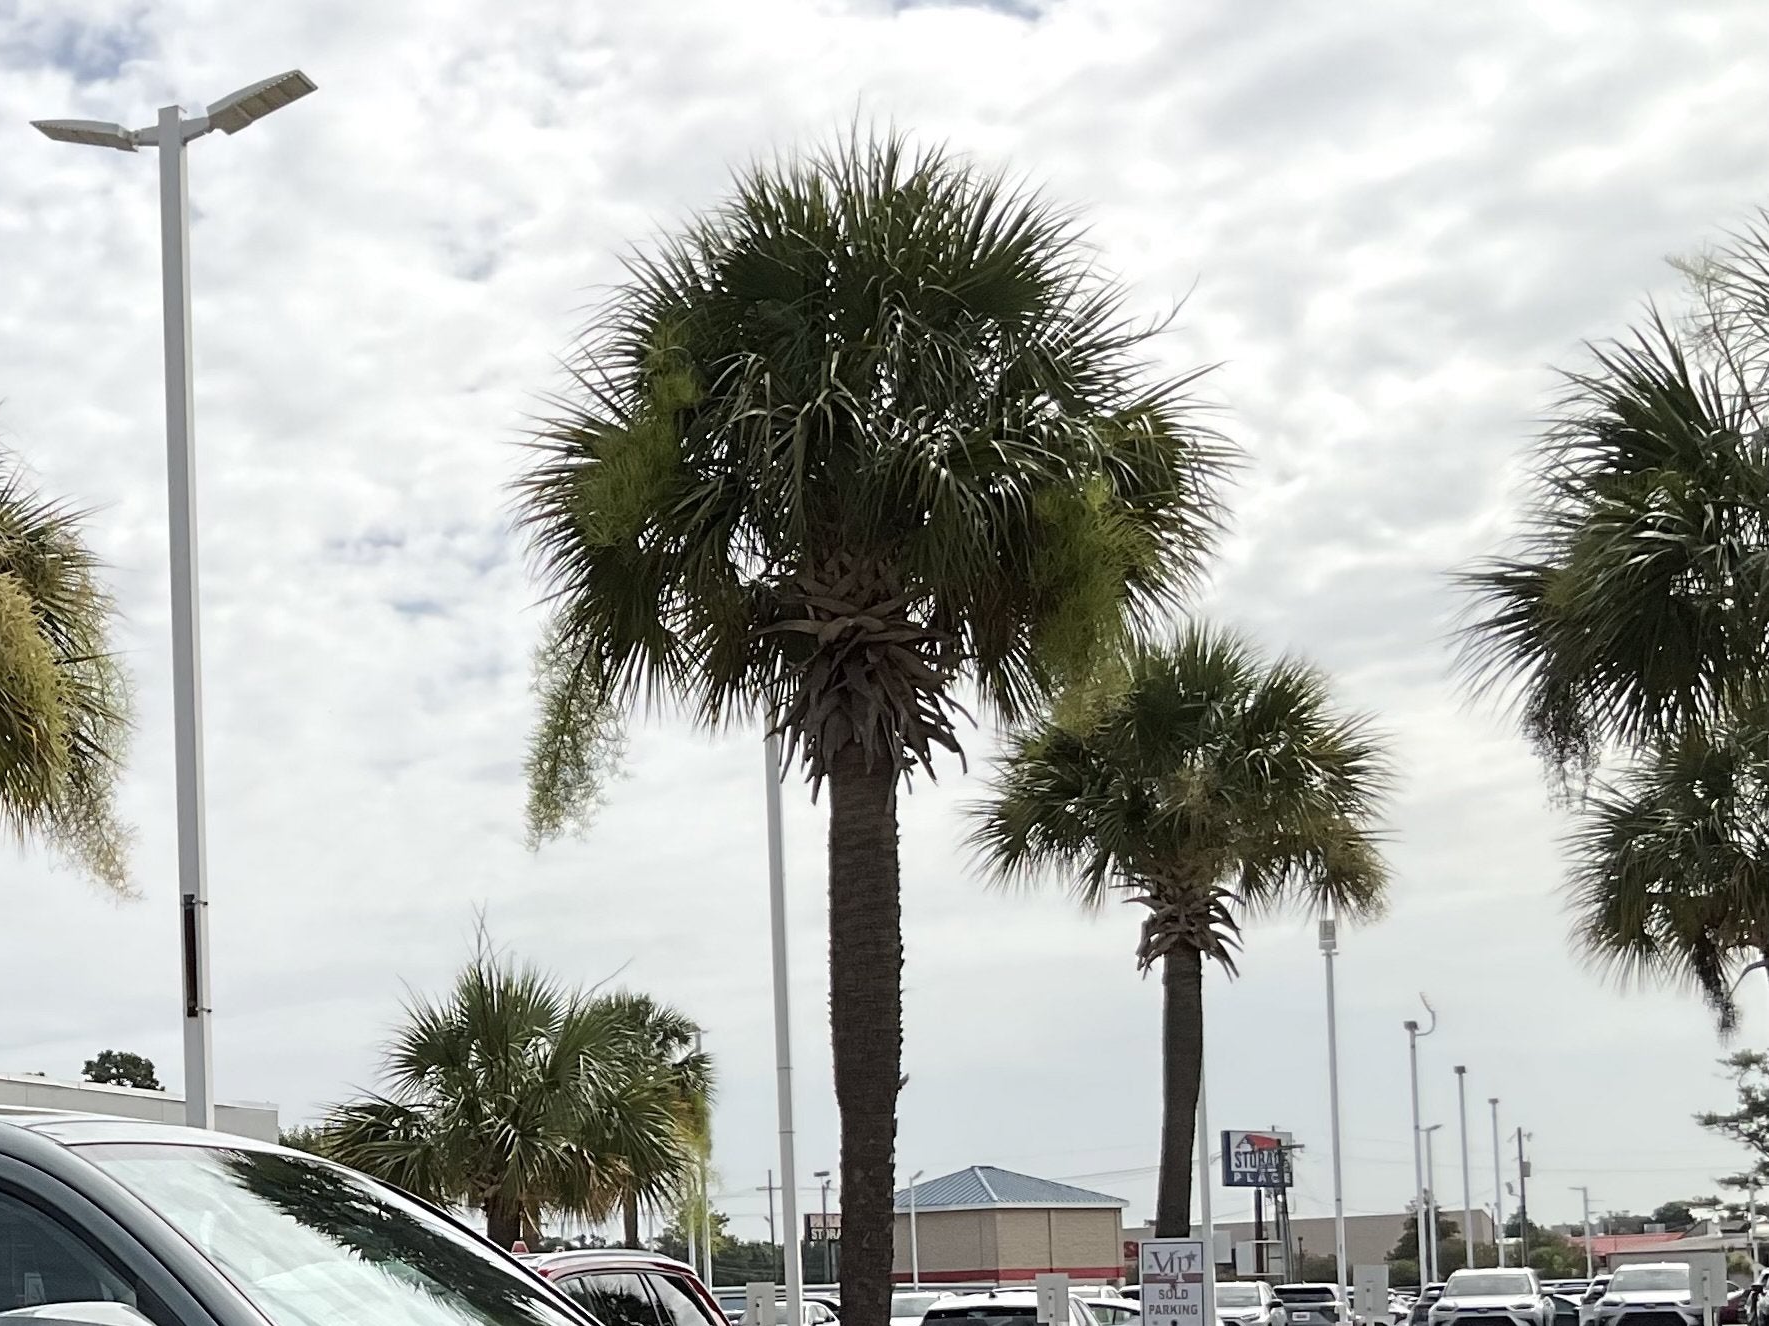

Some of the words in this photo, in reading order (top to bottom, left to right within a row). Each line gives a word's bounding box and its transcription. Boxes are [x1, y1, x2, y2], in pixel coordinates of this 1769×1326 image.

[1234, 1172, 1291, 1183] PLACE
[1158, 1289, 1189, 1300] SOLD
[1148, 1304, 1198, 1316] PARKING
